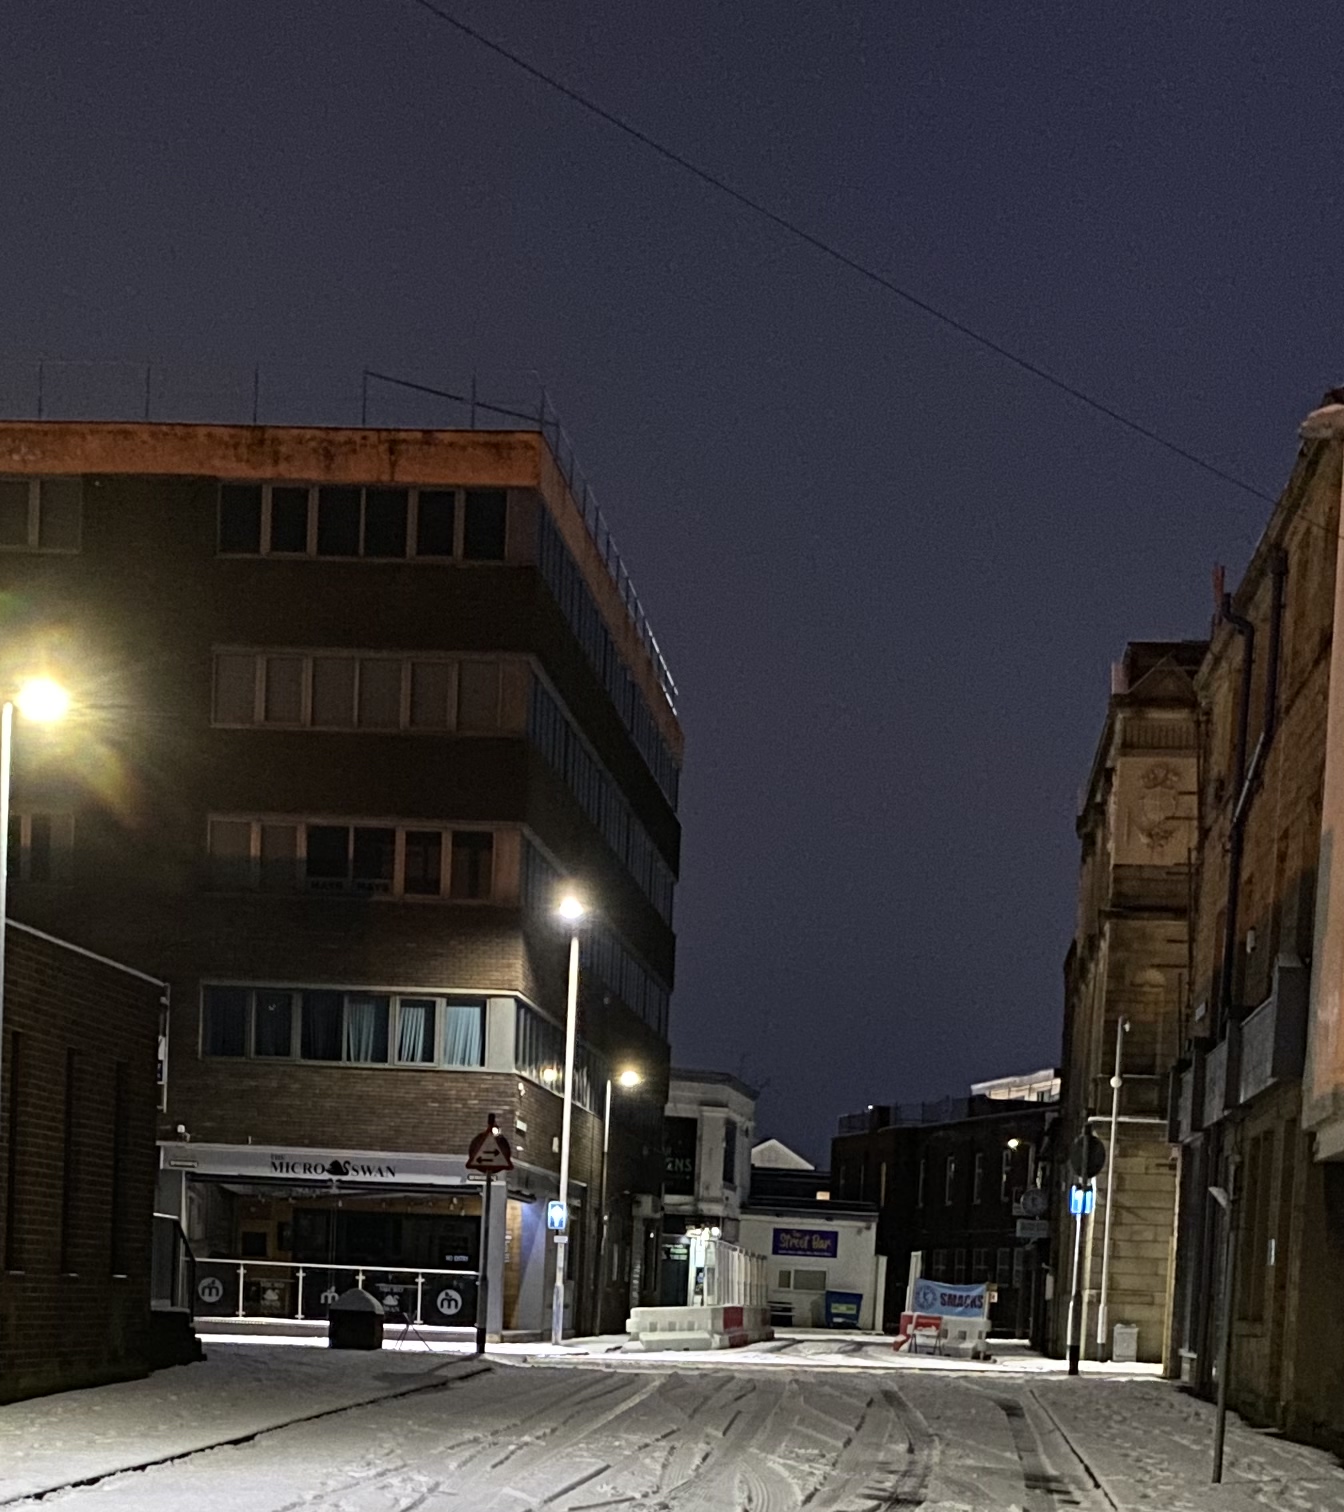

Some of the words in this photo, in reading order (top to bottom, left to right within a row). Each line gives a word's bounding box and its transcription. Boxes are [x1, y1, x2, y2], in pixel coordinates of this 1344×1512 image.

[270, 1161, 326, 1175] MICRO
[351, 1164, 396, 1178] SWAN
[779, 1232, 810, 1249] Street
[812, 1234, 833, 1250] Bar
[939, 1292, 984, 1309] SMACKS
